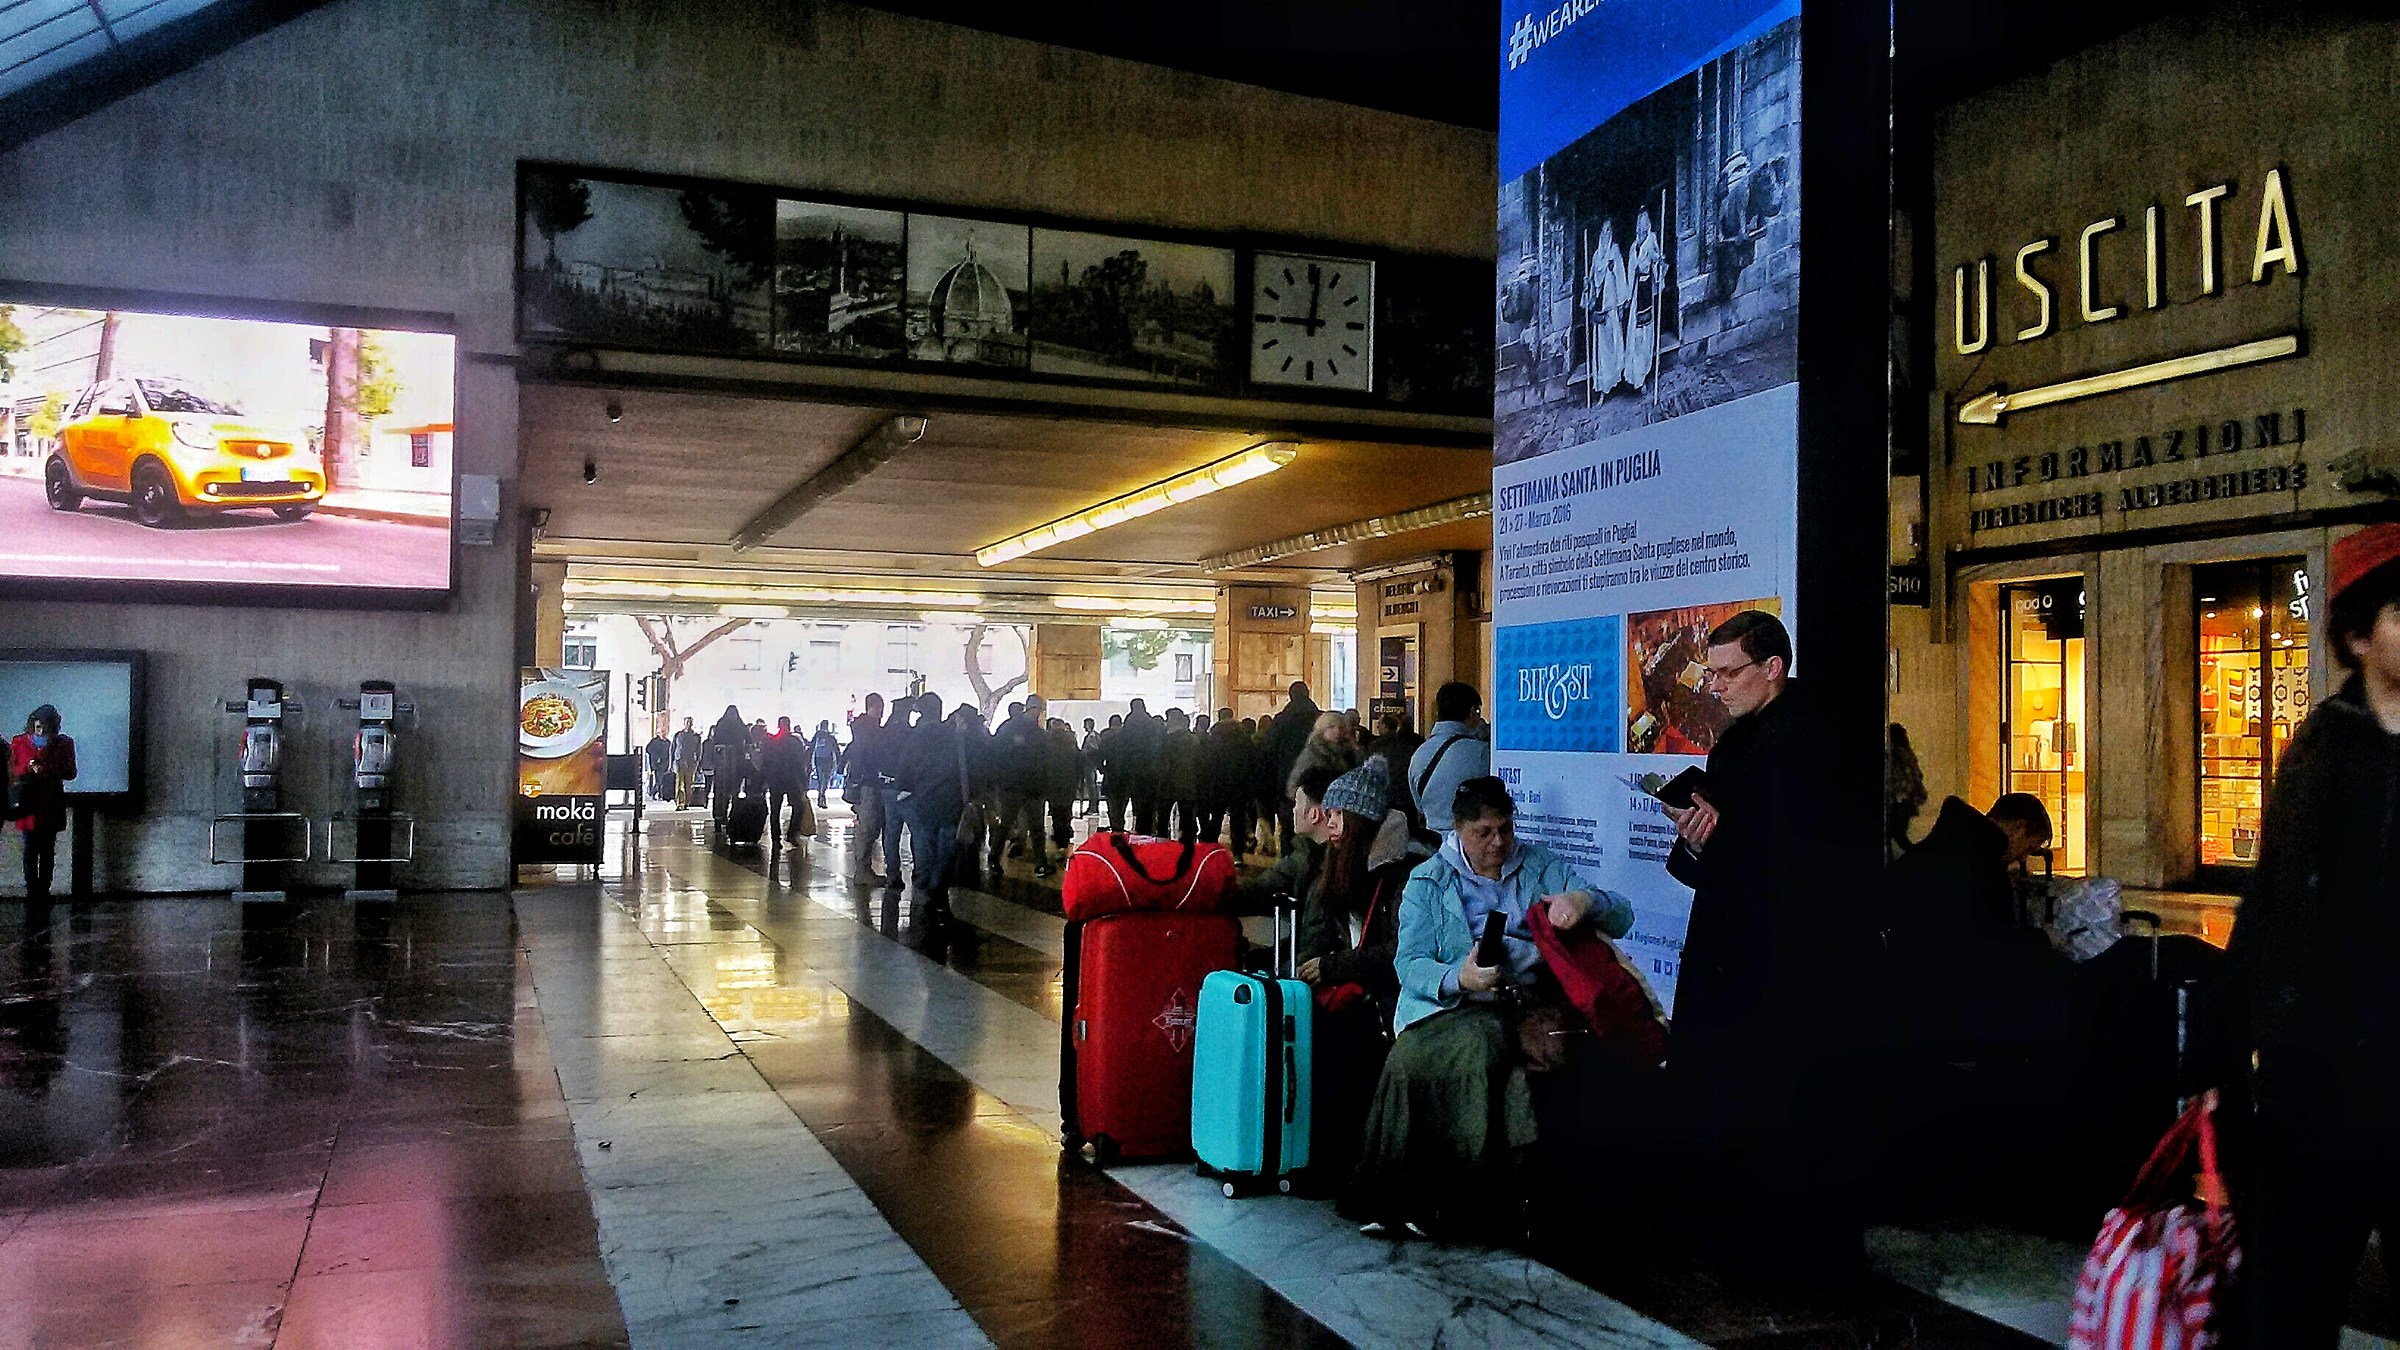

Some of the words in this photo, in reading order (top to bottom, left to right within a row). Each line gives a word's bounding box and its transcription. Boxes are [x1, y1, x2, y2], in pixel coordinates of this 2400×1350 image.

[1954, 168, 2298, 355] USCITA
[1968, 408, 2307, 494] INFORMAZIONI
[1500, 475, 1559, 512] SETTIMANA
[1561, 465, 1598, 498] SANTA
[1600, 461, 1613, 490] IN
[1616, 449, 1662, 486] PUGLIA
[2118, 463, 2308, 512] ALBERGHIERE
[1499, 517, 1507, 535] 21
[1514, 513, 1523, 532] 27
[1529, 511, 1551, 529] Marzo
[1552, 503, 1572, 525] 2016
[1573, 526, 1602, 552] pasquali
[1604, 528, 1612, 544] in
[1612, 519, 1637, 544] Puglia!
[1576, 551, 1592, 570] della
[1593, 547, 1632, 567] Settimana
[1632, 541, 1655, 561] Santa
[1656, 535, 1690, 560] pugliese
[1691, 530, 1705, 551] nel
[1705, 525, 1738, 548] mondo,
[1629, 566, 1641, 585] tra
[1642, 563, 1649, 582] le
[1676, 556, 1689, 577] del
[1690, 554, 1717, 576] centro
[1718, 549, 1751, 573] storico.
[1251, 605, 1279, 618] TAXI
